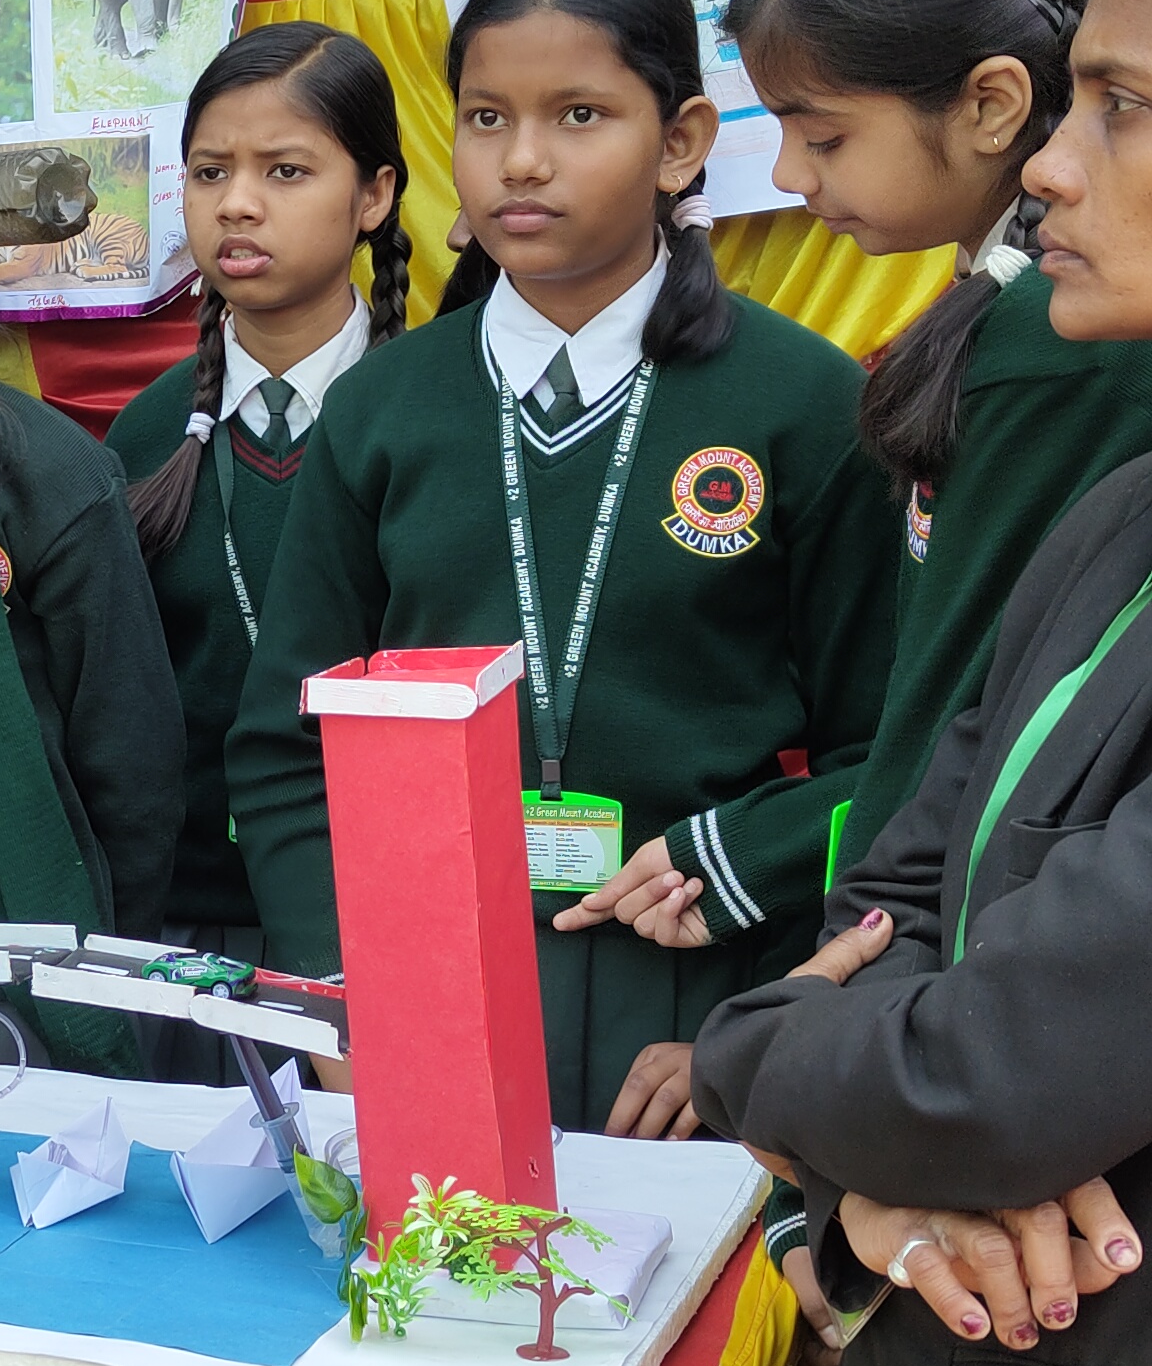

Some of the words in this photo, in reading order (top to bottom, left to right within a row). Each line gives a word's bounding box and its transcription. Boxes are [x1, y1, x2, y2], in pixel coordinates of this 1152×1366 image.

[92, 113, 152, 130] ELEPHANT
[502, 412, 515, 449] MOUNT
[617, 417, 638, 453] GREEN
[628, 376, 647, 415] MOUNT
[504, 449, 519, 486] GREEN
[677, 461, 700, 496] GREEN
[697, 451, 740, 467] MOUNT
[735, 458, 761, 512] ACADEMY
[598, 483, 620, 524] DUMKA
[224, 531, 238, 567] DUMKA
[510, 516, 525, 556] DUMKA
[584, 525, 610, 580] ACADEMY,
[670, 519, 750, 554] DUMKA
[515, 555, 534, 612] ACADEMY,
[574, 581, 594, 623] MOUNT
[522, 614, 540, 657] MOUNT
[566, 621, 586, 662] GREEN
[527, 655, 548, 692] GREEN
[536, 806, 558, 818] Green
[559, 807, 581, 819] Mount
[583, 808, 616, 821] Academy
